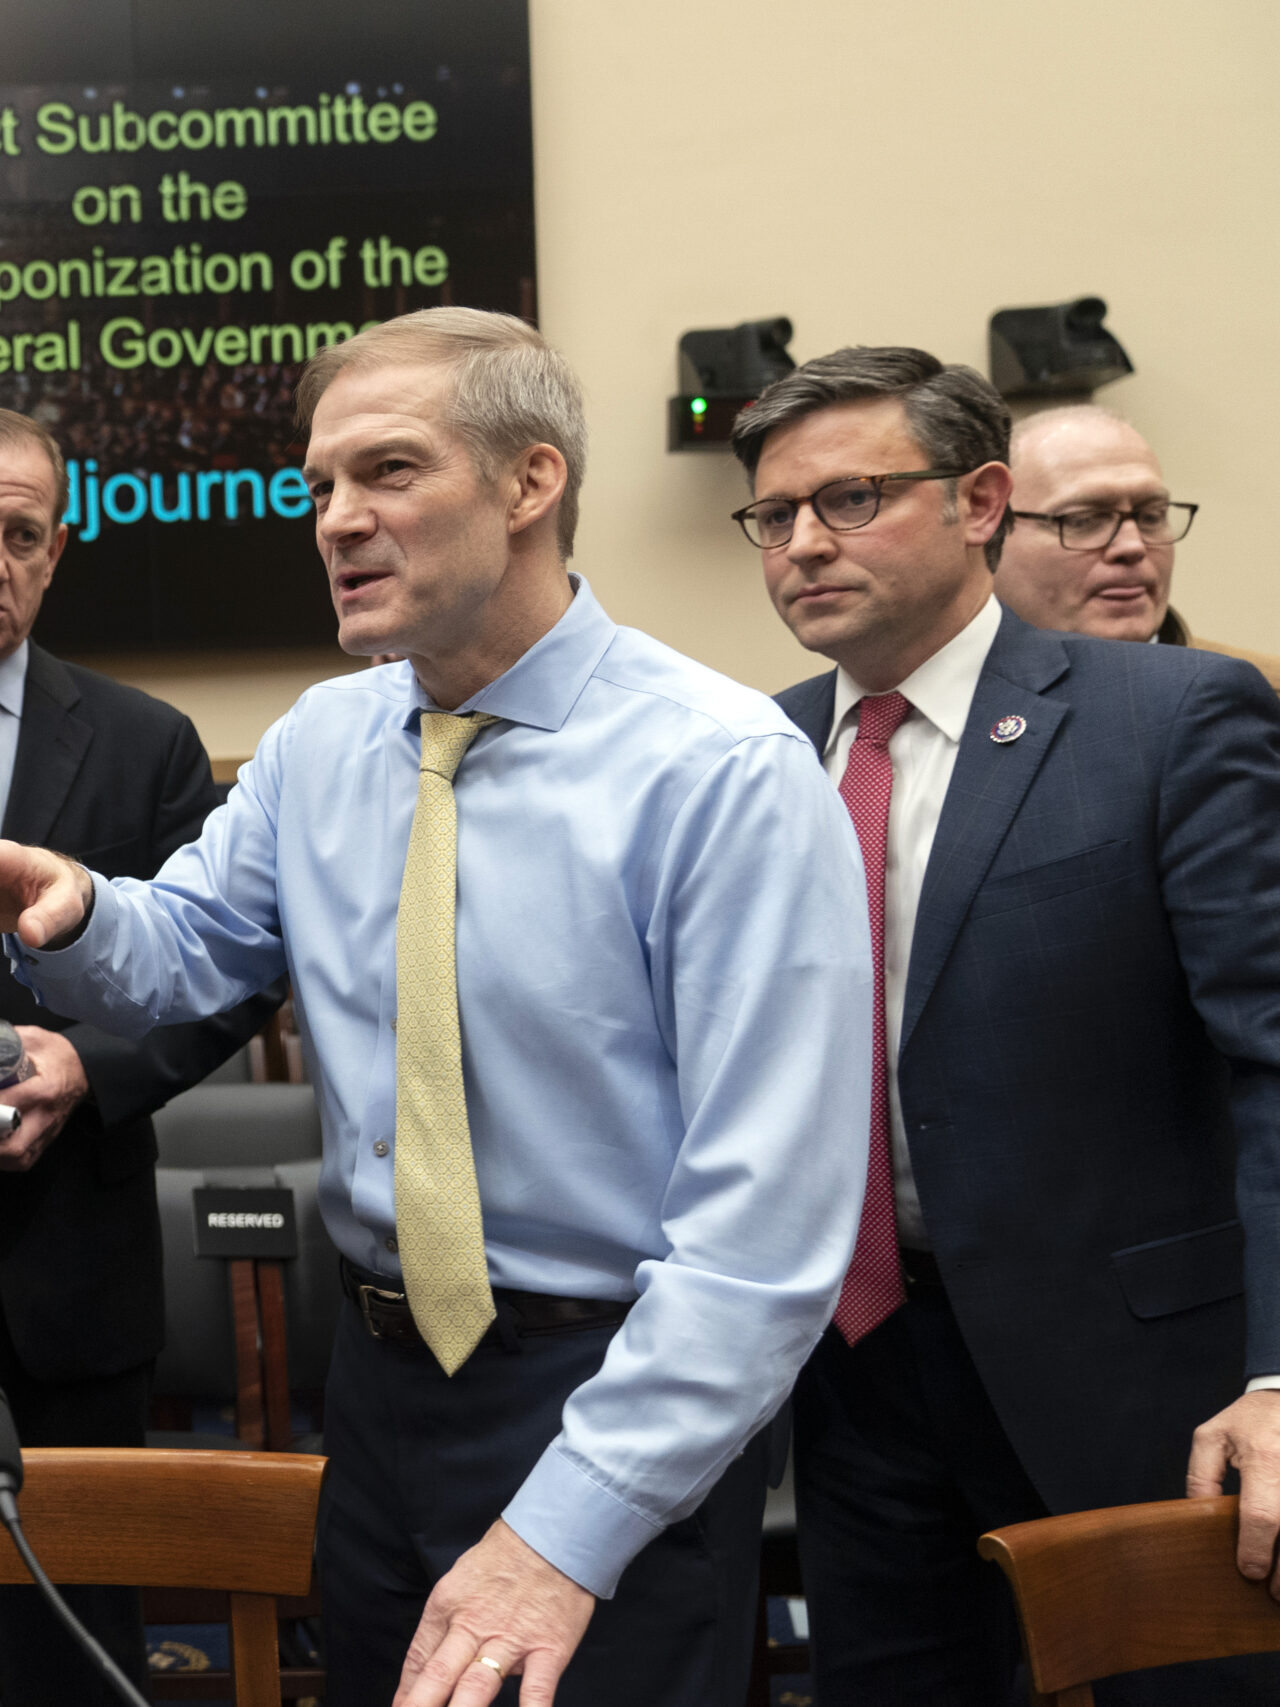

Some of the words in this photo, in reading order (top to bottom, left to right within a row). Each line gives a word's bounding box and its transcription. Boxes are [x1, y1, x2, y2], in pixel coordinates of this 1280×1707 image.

[37, 93, 437, 155] Subcommittee
[72, 185, 141, 226] on
[160, 172, 247, 222] the
[290, 236, 347, 291] of
[360, 236, 448, 288] the
[99, 317, 380, 370] Governm
[208, 1212, 284, 1229] RESERVED
